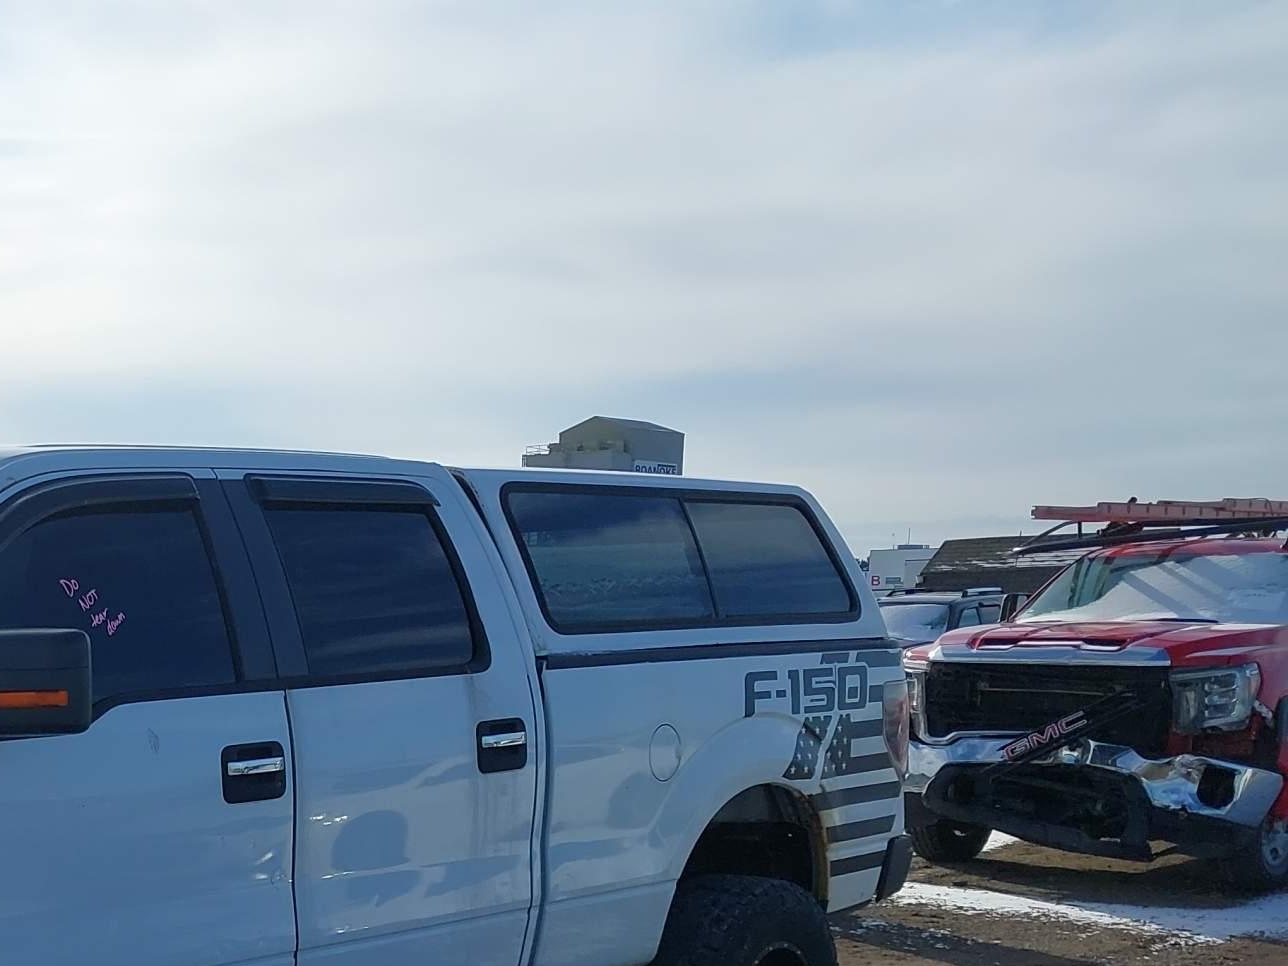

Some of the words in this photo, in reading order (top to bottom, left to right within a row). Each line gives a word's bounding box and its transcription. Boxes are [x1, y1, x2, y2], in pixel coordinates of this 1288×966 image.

[60, 578, 79, 598] Do
[78, 589, 99, 612] NOT
[745, 664, 868, 717] F-150
[1003, 710, 1088, 762] GMC
